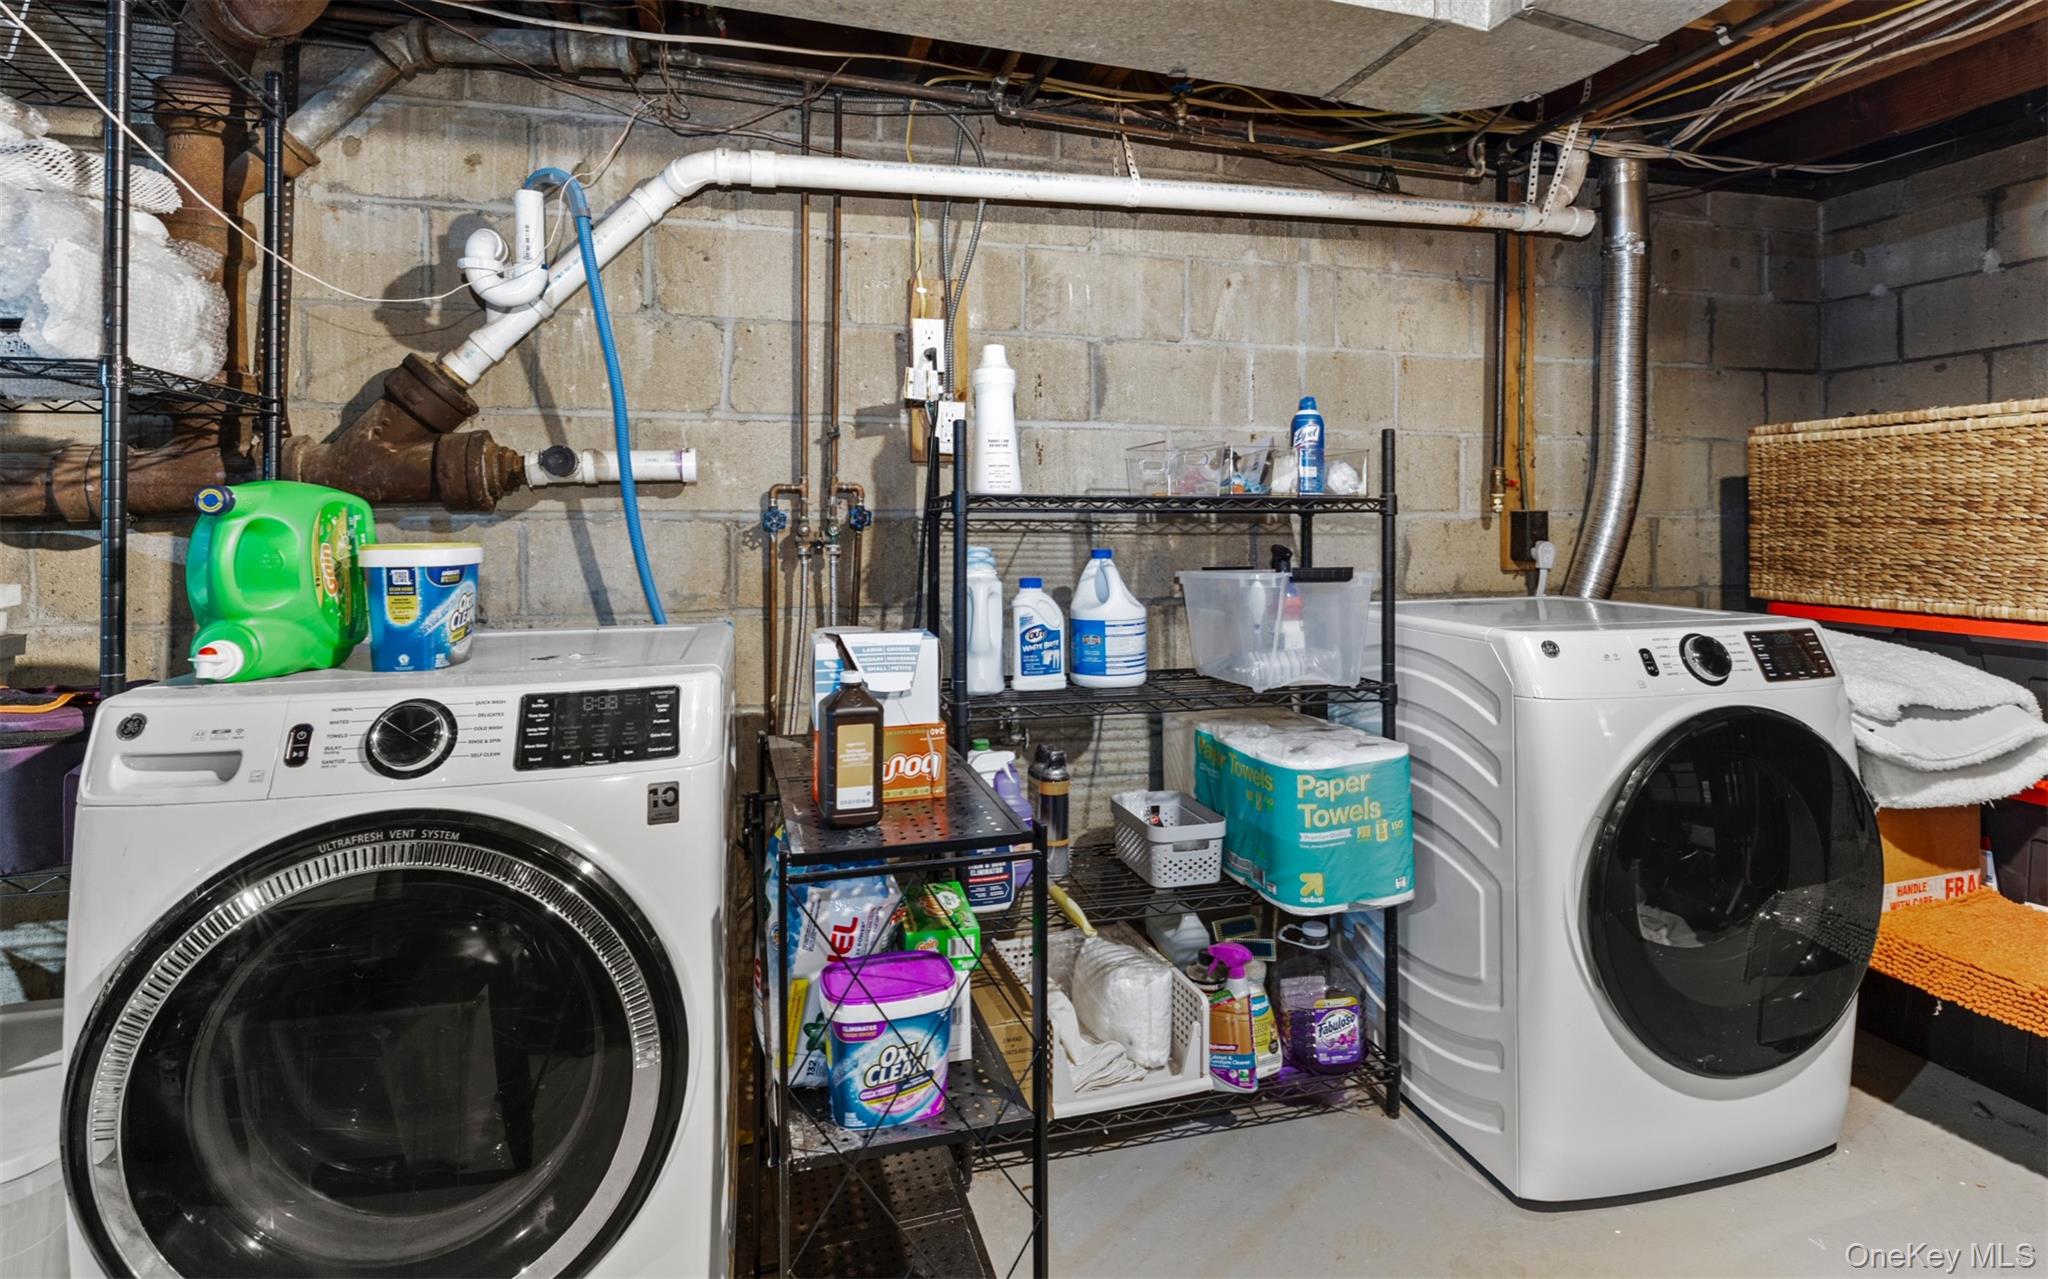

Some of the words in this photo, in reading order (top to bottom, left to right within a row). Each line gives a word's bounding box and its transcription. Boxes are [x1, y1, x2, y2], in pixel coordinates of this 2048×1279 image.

[1295, 427, 1318, 443] Lysol
[1228, 751, 1276, 793] Towels
[1297, 773, 1371, 802] Paper
[1297, 797, 1382, 828] Towels
[318, 831, 384, 854] ULTRAFRESH
[389, 828, 416, 840] VENT
[421, 828, 461, 841] SYSTEM
[1897, 882, 1928, 897] HANDLE
[1317, 1013, 1356, 1039] Fabuloso
[879, 1041, 919, 1068] OXI
[806, 1060, 817, 1076] 132
[863, 1052, 929, 1089] CLEAN
